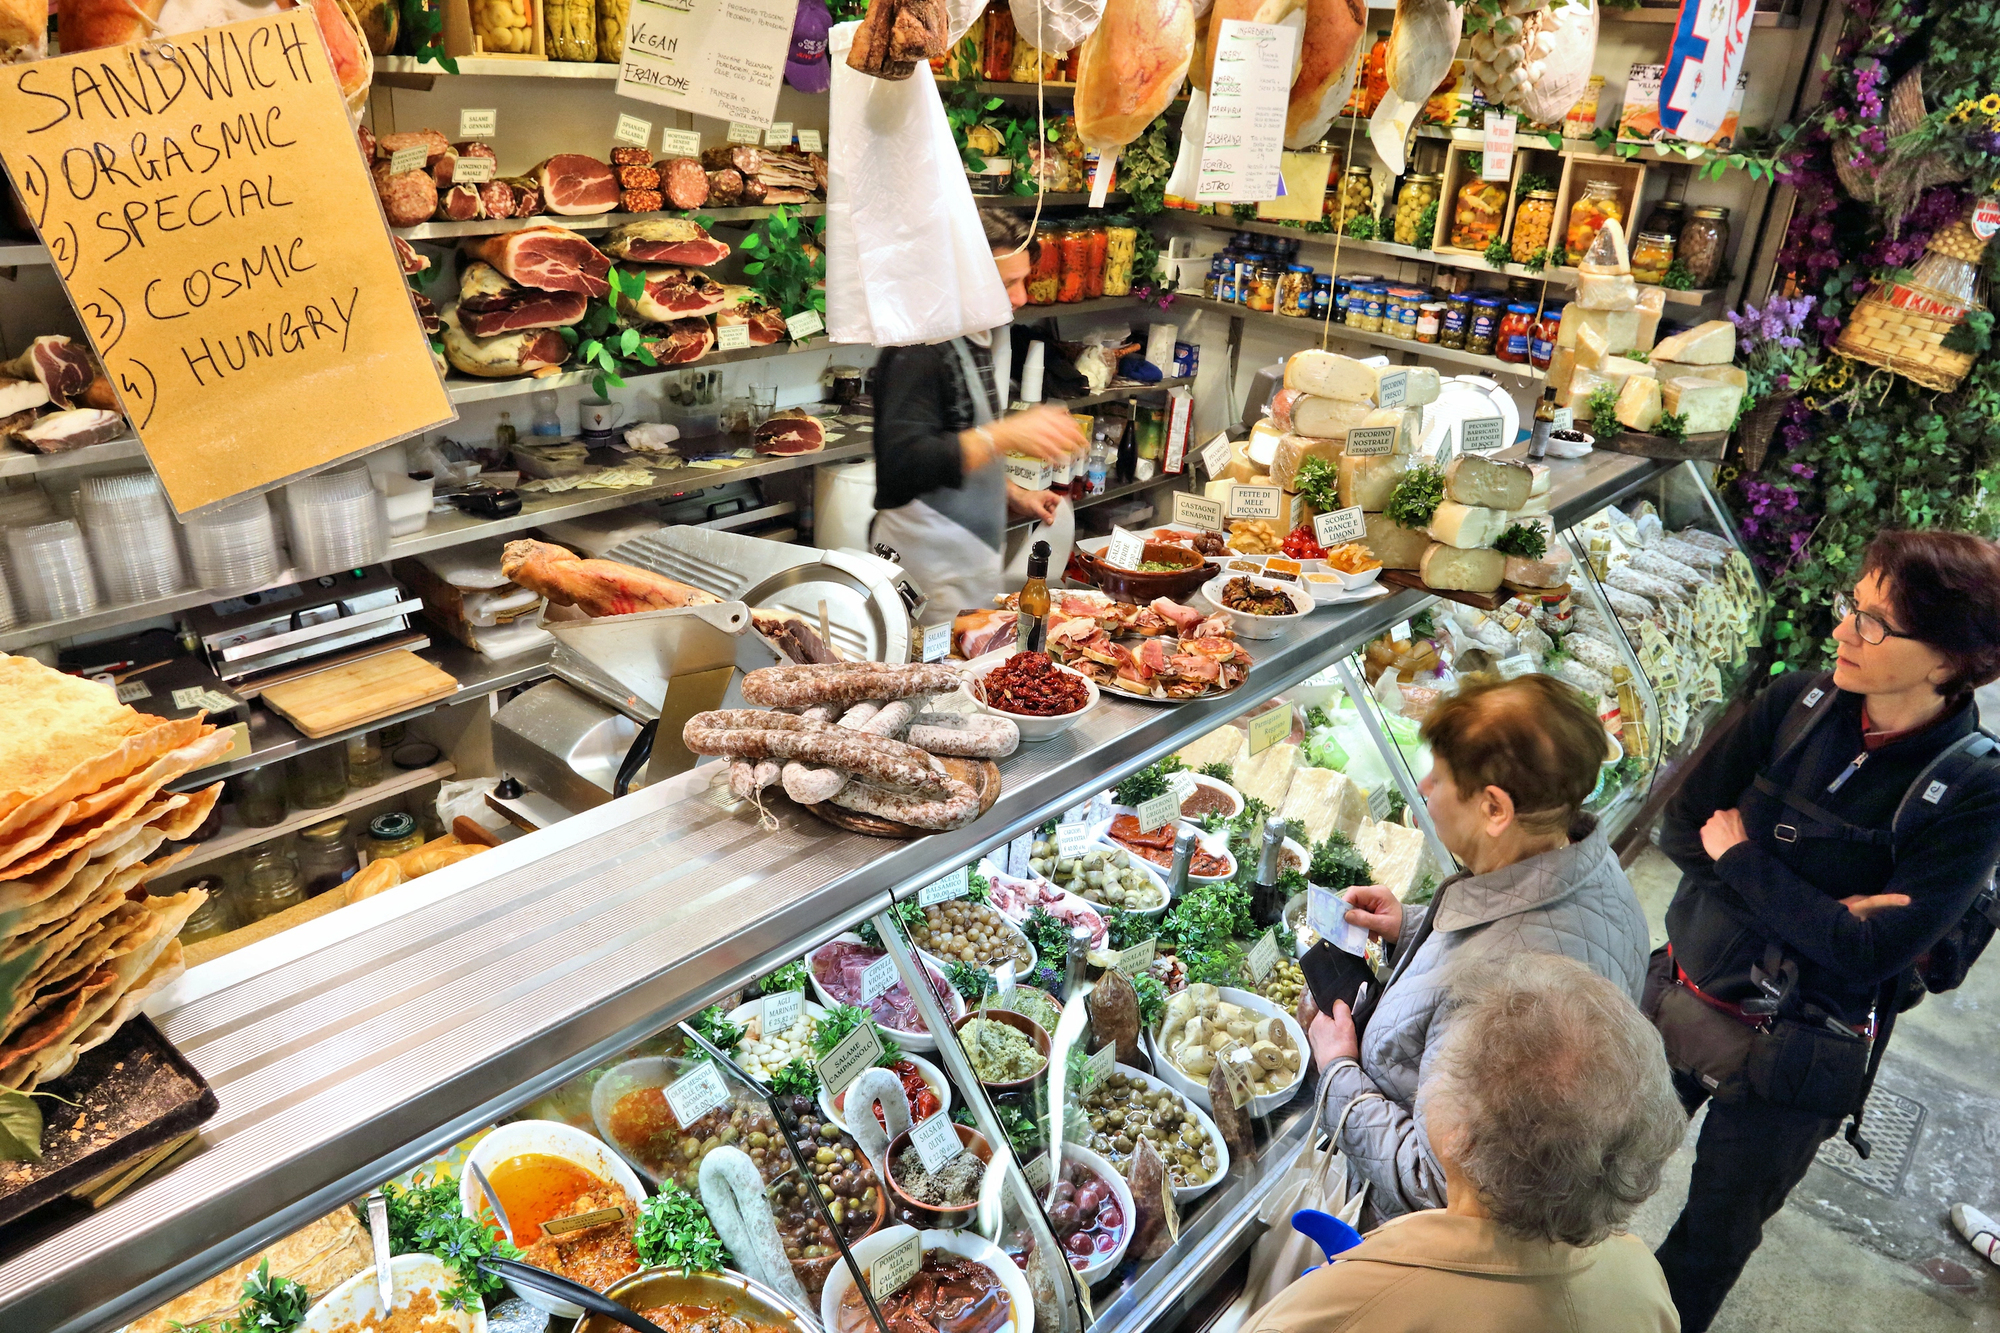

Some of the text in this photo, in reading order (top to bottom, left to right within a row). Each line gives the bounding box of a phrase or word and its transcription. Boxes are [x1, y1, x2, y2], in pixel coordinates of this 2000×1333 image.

[632, 23, 678, 53] VEGAN
[18, 23, 312, 133] SANDWICH
[625, 63, 690, 91] FRANCONE
[621, 129, 644, 140] CALABRA
[622, 122, 646, 133] SPIANATA
[26, 106, 297, 229] 1) ORGASMIC
[52, 175, 294, 281] 2) SPECIAL
[82, 237, 318, 360] 3) COSMIC
[120, 286, 359, 430] 4) HUNGRY
[1382, 378, 1405, 391] PECORINO
[1384, 390, 1402, 400] FRESCO
[1354, 430, 1391, 438] PECORINO
[1181, 501, 1216, 514] CASTAGNE
[1181, 509, 1215, 522] SENAPATE
[1325, 512, 1353, 525] SCORZE
[1324, 522, 1352, 534] ARANCE
[1329, 529, 1356, 540] LIMONI
[1111, 540, 1122, 561] SALSA
[1119, 543, 1130, 564] VERDE
[929, 630, 947, 642] SALAME
[926, 641, 948, 654] PICCANTE
[1255, 713, 1281, 729] Parmigiano
[1265, 721, 1285, 734] Reggiano
[1145, 797, 1172, 812] PEPERONI
[1146, 804, 1174, 819] GRIGLIATI
[926, 880, 961, 894] BALSAMICO
[1120, 948, 1150, 965] INSALATA
[869, 959, 891, 976] CIPOLLE
[1130, 958, 1146, 970] MARE
[869, 971, 885, 985] VIOLA
[869, 974, 893, 995] MORGAN
[778, 997, 790, 1006] AGLI
[770, 1003, 798, 1017] MARINATI
[835, 1042, 860, 1068] SALAME
[829, 1041, 873, 1084] CAMPAGNOLO
[671, 1084, 688, 1098] OLIVE
[682, 1089, 695, 1100] ALLE
[682, 1083, 716, 1110] AROMATICHE
[920, 1119, 944, 1142] SALSA DI
[928, 1133, 946, 1150] OLIVE
[879, 1242, 913, 1268] POMODORI
[889, 1257, 904, 1270] ALLA
[880, 1259, 913, 1285] CALABRESE
[880, 1286, 884, 1294] €
